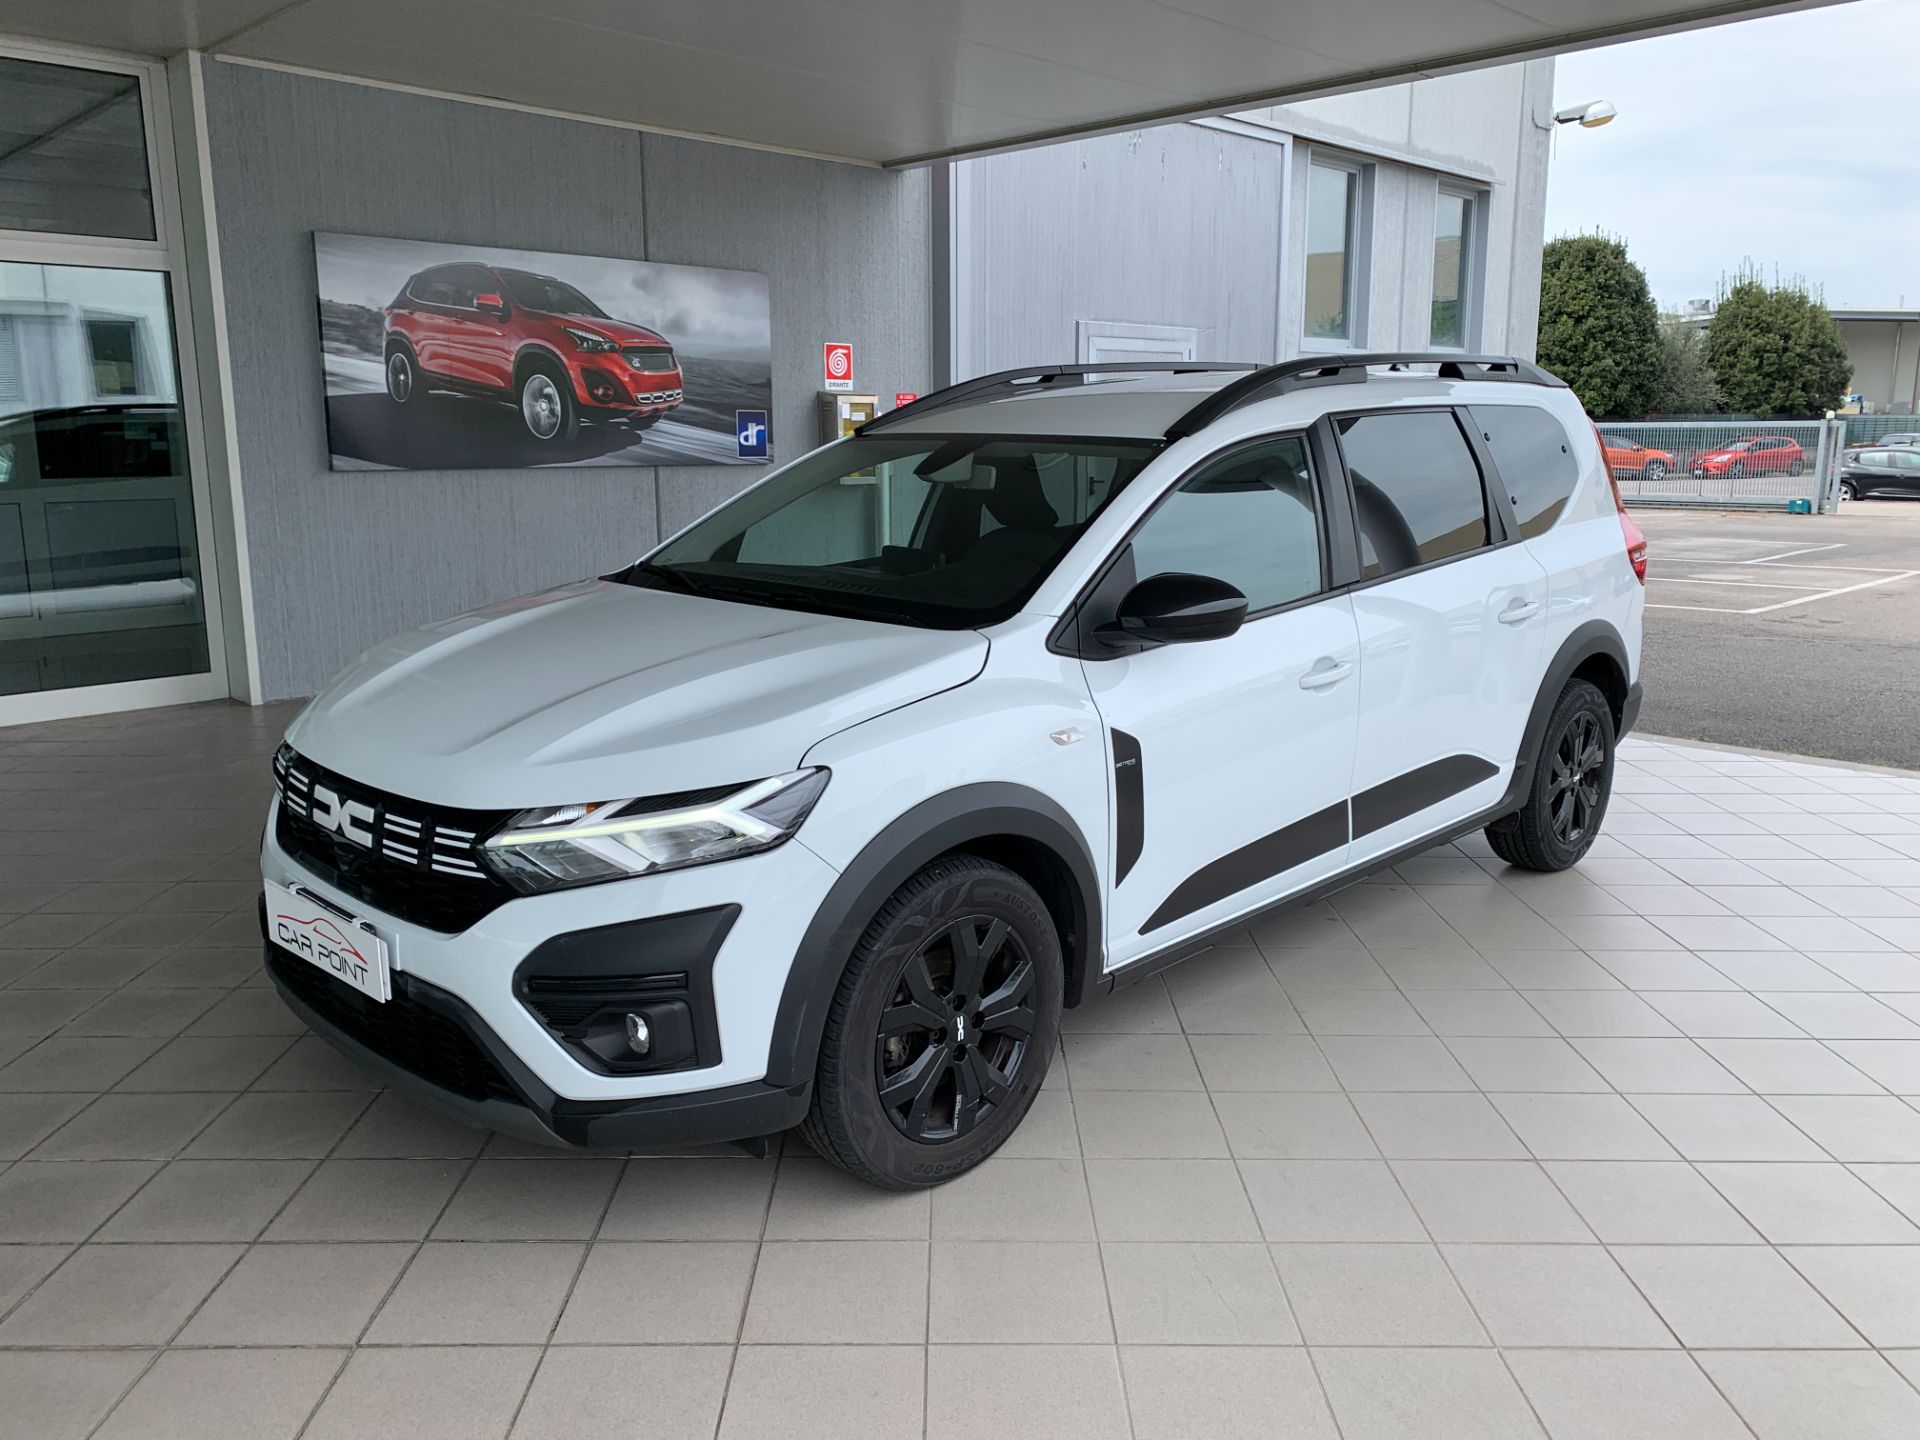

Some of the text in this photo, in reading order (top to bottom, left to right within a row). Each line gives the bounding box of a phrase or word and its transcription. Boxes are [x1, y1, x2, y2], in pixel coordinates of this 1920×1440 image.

[740, 423, 764, 446] dr
[278, 922, 369, 985] CAR POINT
